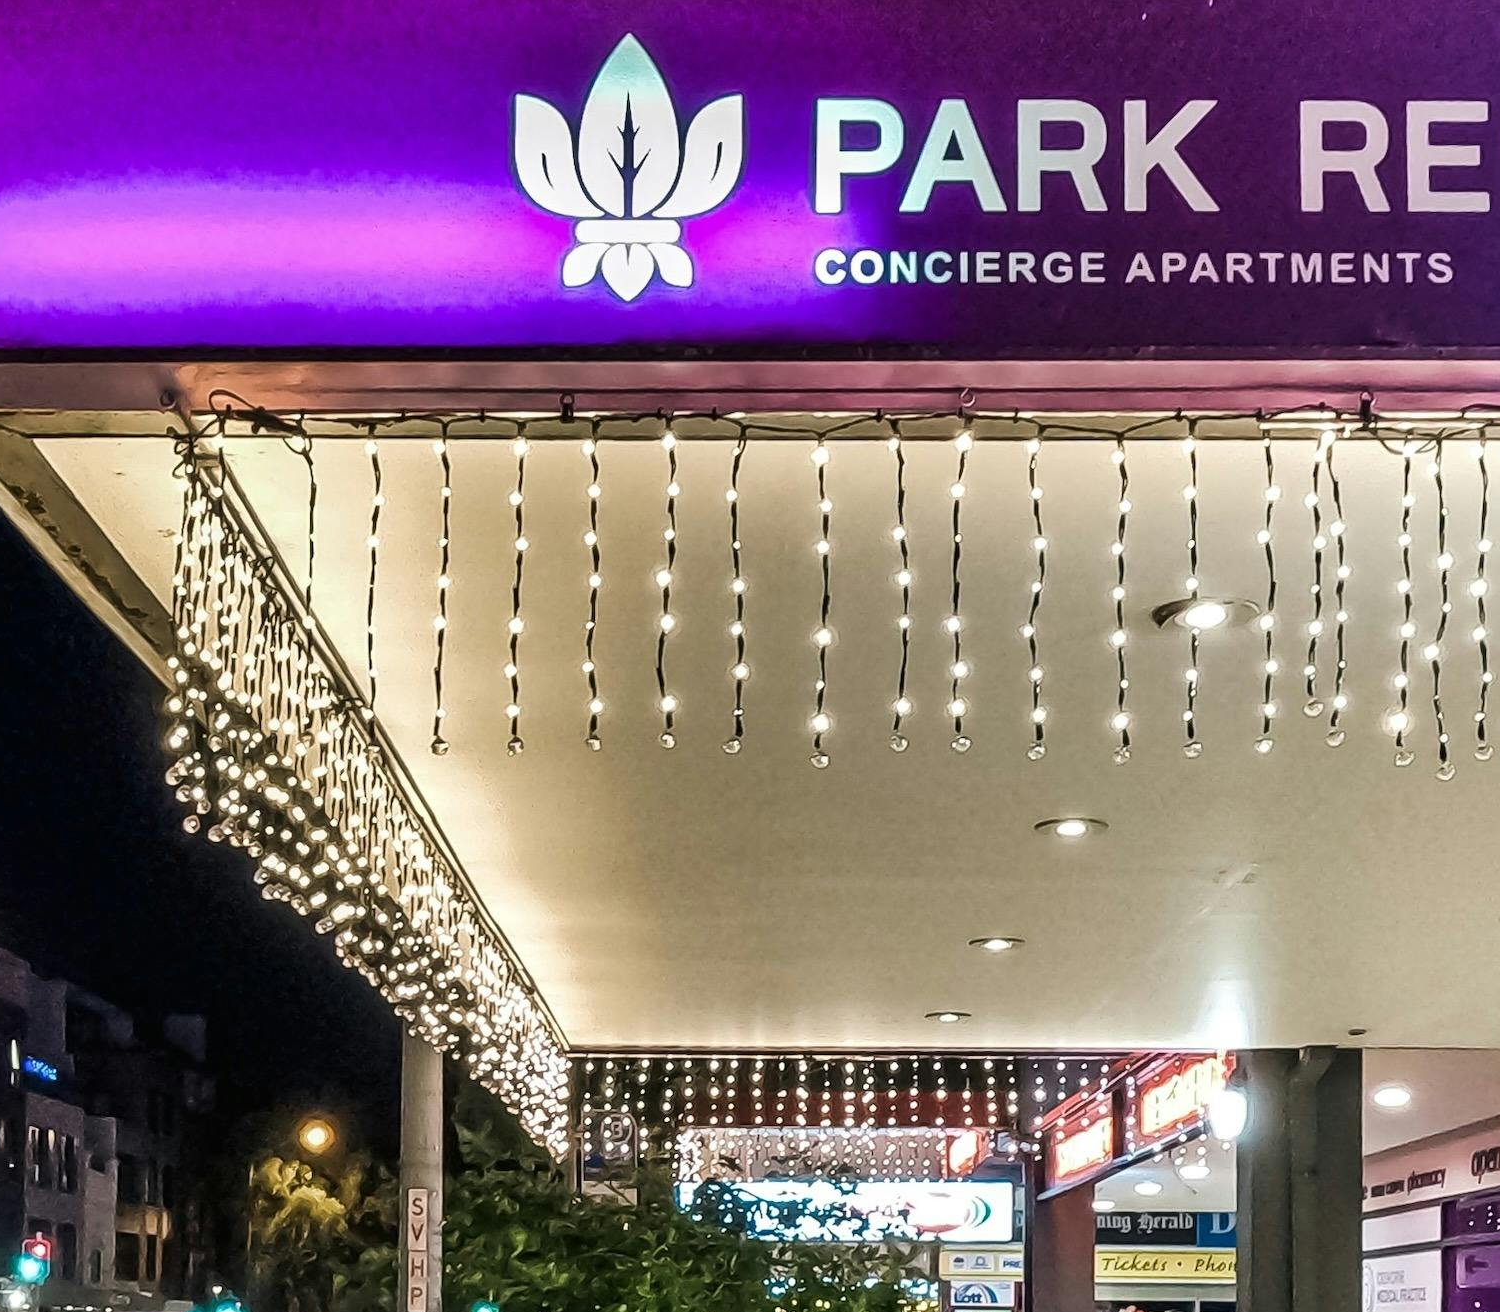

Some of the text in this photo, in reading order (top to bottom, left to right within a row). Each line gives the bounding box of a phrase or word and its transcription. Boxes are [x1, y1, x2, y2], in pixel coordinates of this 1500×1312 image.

[814, 98, 1220, 214] PARK
[814, 248, 1454, 285] CONCIERGE APARTMENTS
[1137, 1213, 1194, 1235] Herald
[1101, 1254, 1168, 1272] Tickets
